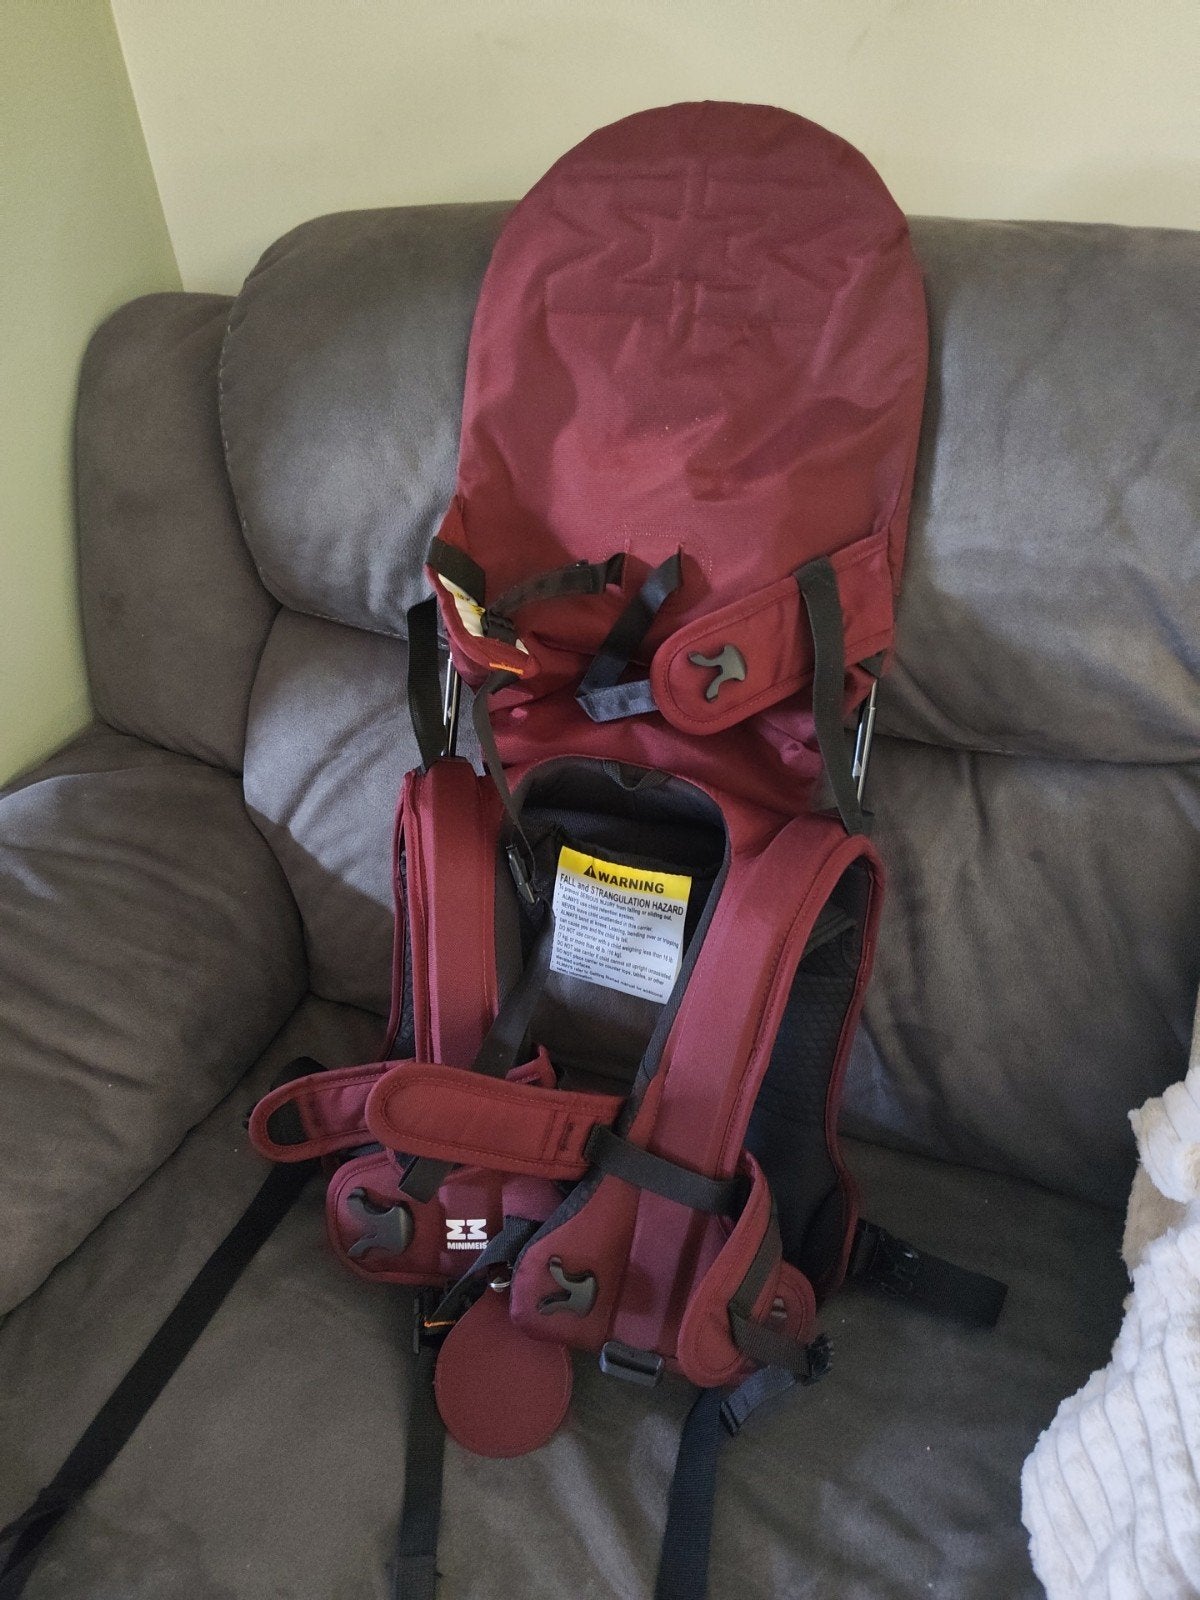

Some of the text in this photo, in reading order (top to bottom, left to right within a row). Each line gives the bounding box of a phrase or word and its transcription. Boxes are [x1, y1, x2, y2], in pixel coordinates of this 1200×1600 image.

[598, 871, 664, 894] WARNING
[560, 873, 684, 916] FALL and STRANGULATION HAZARD
[447, 1241, 487, 1250] MINIMEIS
